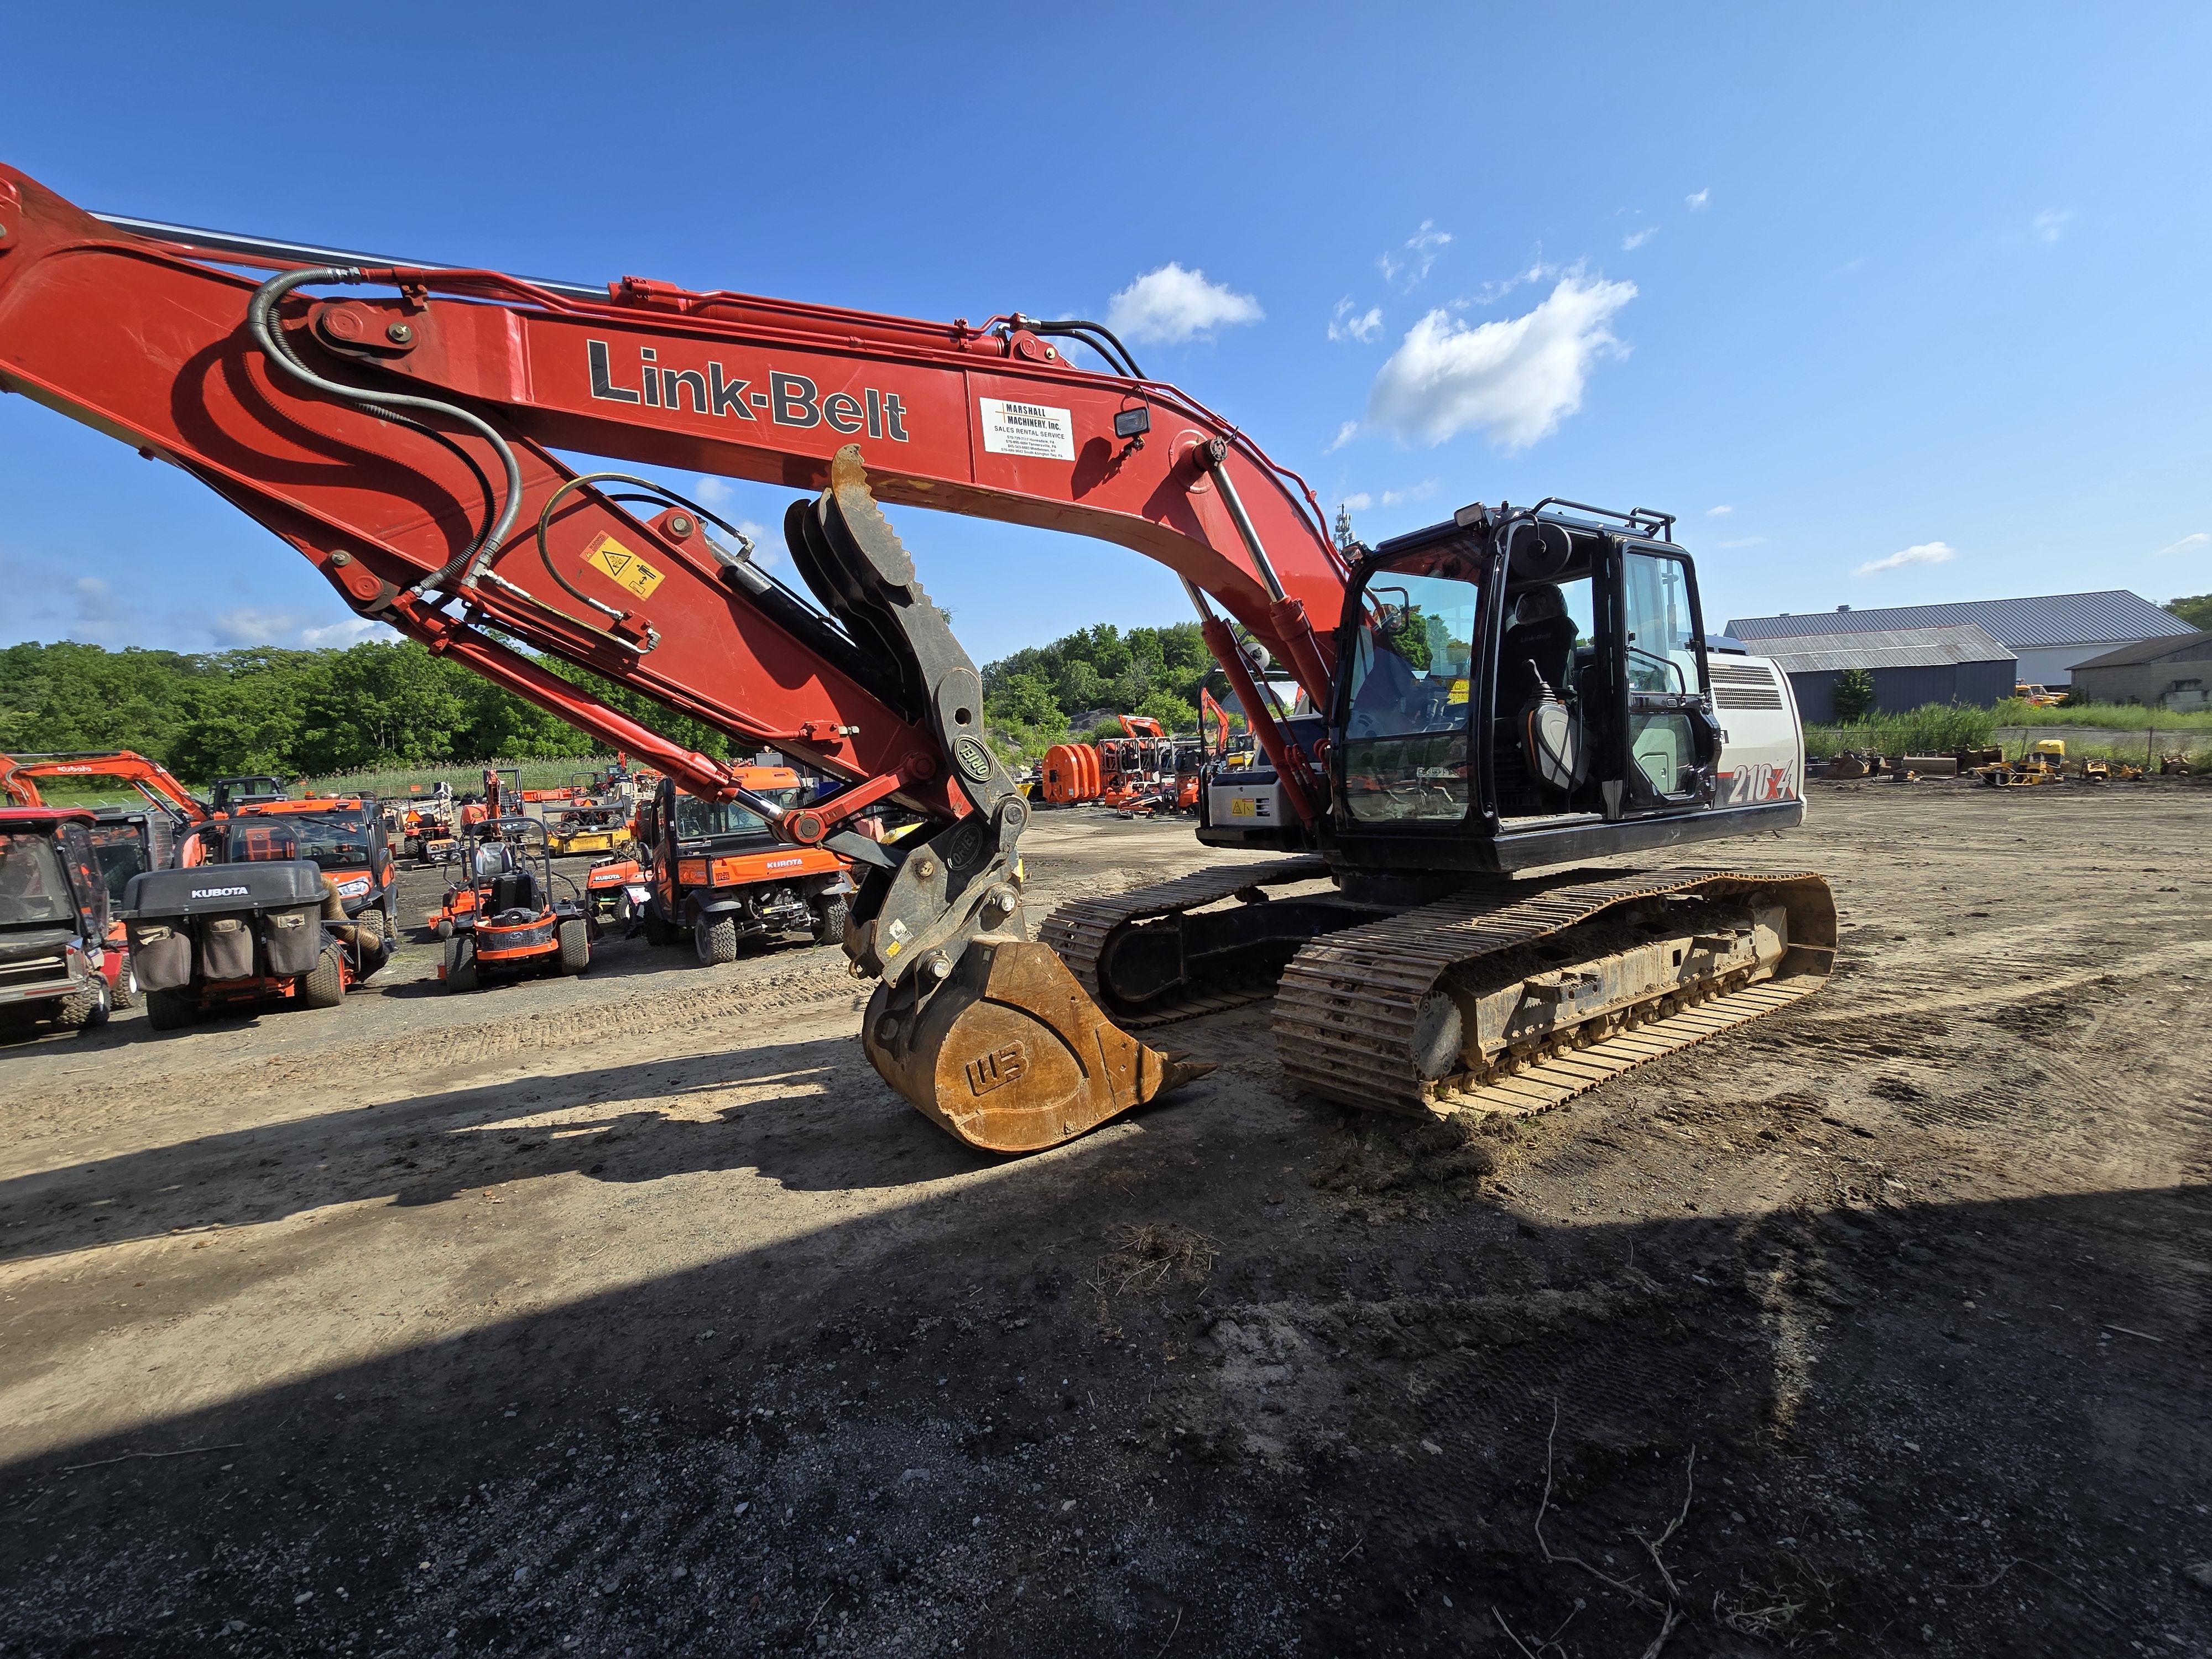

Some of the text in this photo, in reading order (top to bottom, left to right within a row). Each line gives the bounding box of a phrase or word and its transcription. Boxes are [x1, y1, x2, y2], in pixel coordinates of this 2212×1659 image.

[587, 338, 909, 442] Link-Belt
[1006, 404, 1046, 417] MARSHALL
[1048, 421, 1061, 431] Inc.
[1040, 431, 1065, 440] SERVICE
[959, 744, 989, 775] ORIEL
[953, 831, 975, 864] ORIEL
[766, 858, 803, 869] KUBOTA
[191, 886, 248, 898] KUBOTA
